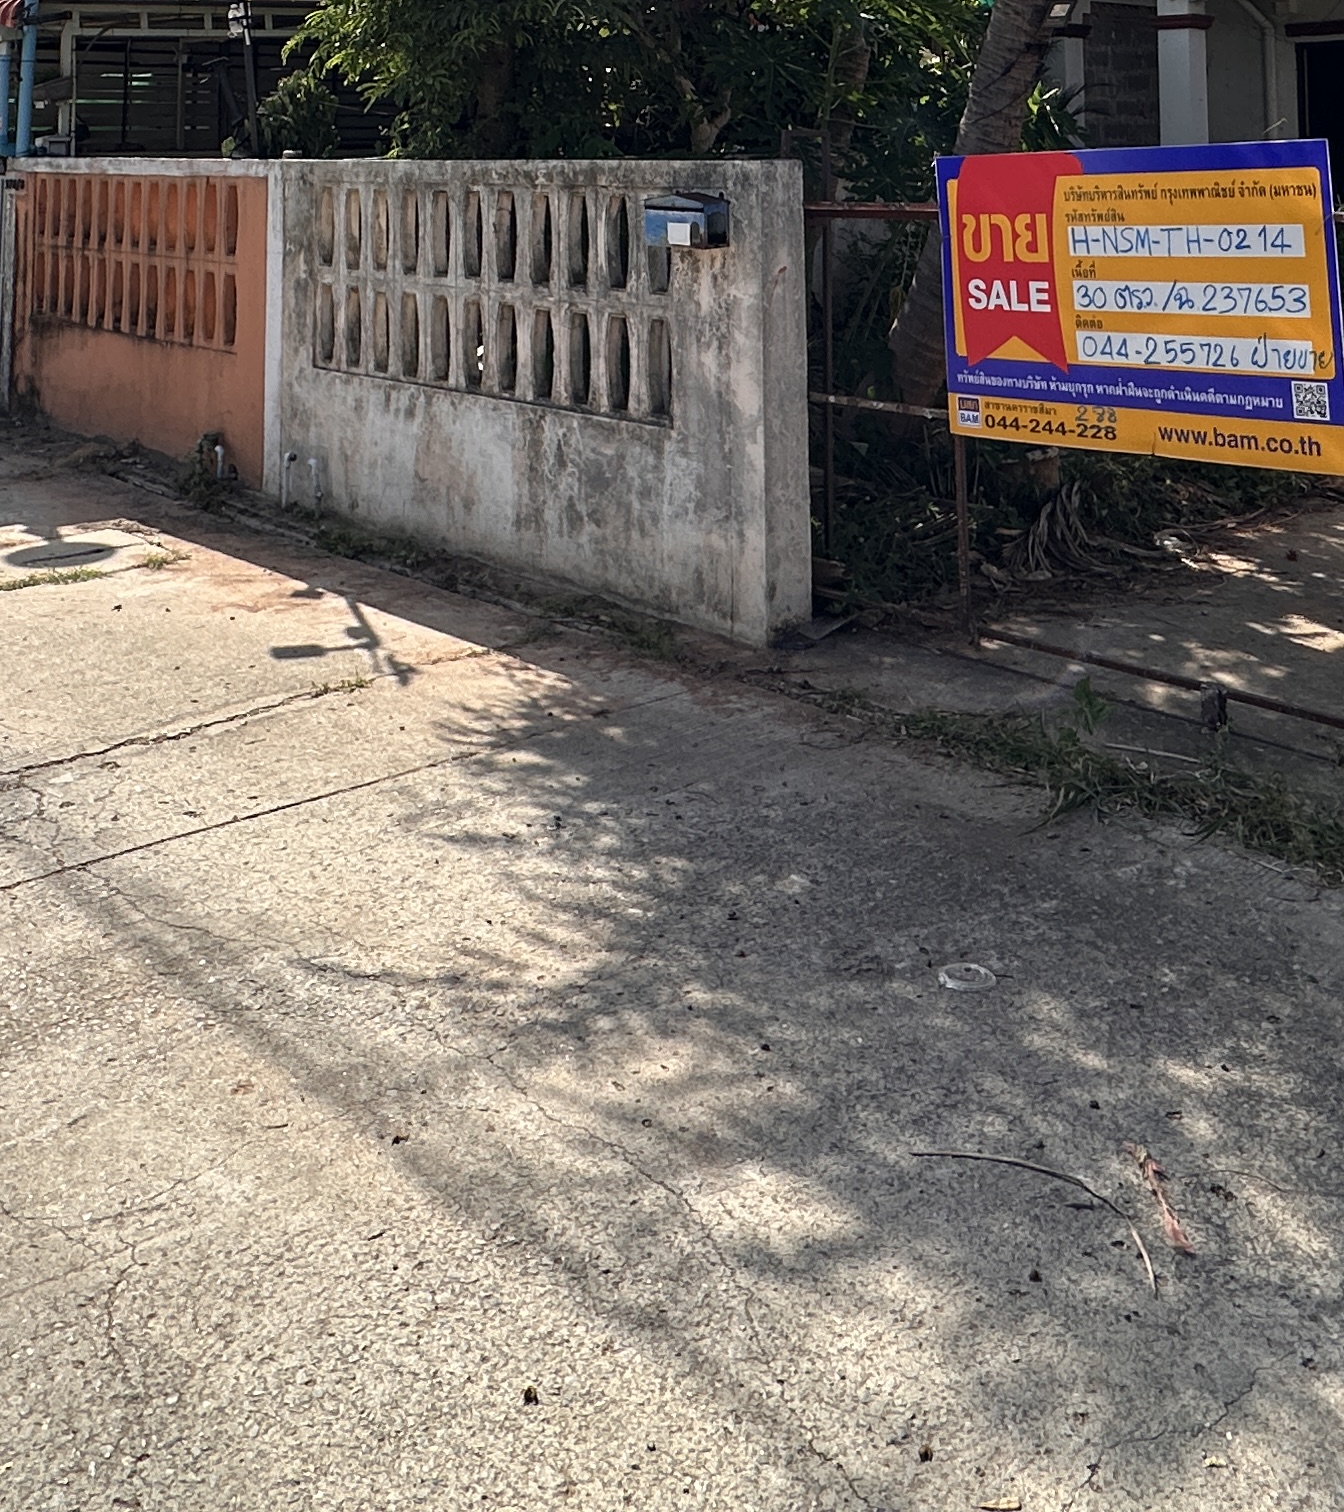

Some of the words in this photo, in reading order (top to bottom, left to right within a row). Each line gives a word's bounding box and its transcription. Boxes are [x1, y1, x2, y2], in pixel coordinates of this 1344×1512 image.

[1063, 182, 1158, 202] บริษัทบริหารสินทรัพย์
[1160, 179, 1236, 205] กรุงเทพพาณิชย์
[1238, 180, 1267, 198] จำกัด
[1269, 182, 1317, 200] (มหาชน)
[1065, 207, 1125, 223] รหัสทรัพย์สิน
[961, 213, 1050, 263] ขาย
[1070, 225, 1292, 256] H-NSM-TH-0214
[1071, 259, 1096, 279] เนื้อที่
[968, 278, 1051, 313] SALE
[1076, 284, 1107, 309] 30
[1075, 313, 1103, 329] ติดต่อ
[957, 370, 1047, 390] ทรัพย์สินของทางบริษัท
[1049, 376, 1093, 399] ห้ามบุกรุก
[1095, 377, 1284, 411] หากฝ่าฝืนจะถูกดำเนินคดีตามกฎหมาย
[960, 412, 980, 425] BAM
[984, 401, 1057, 416] สาขานครราชสีมา
[984, 414, 1118, 441] 044-244-228
[1158, 426, 1322, 457] www.bam.co.th
